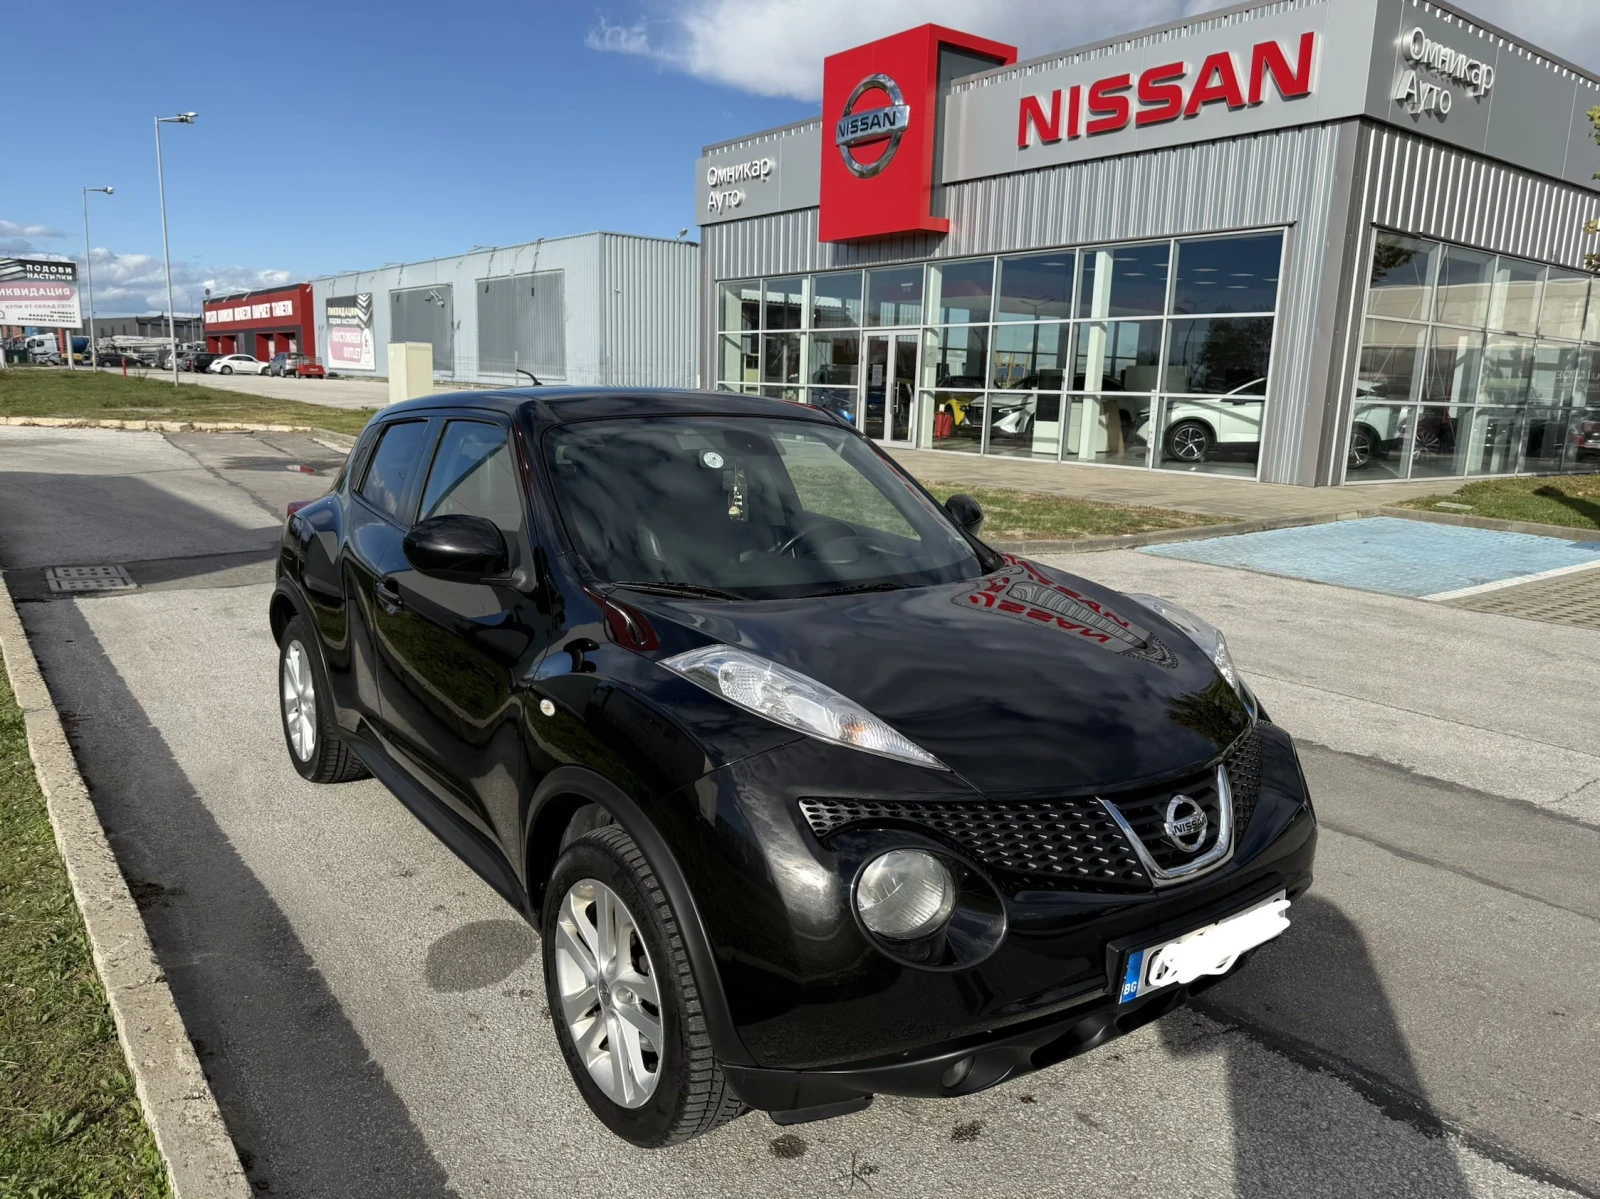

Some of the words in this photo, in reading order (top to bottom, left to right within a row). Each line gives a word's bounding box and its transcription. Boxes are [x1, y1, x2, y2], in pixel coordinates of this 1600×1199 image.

[1404, 26, 1494, 96] Омникар
[1017, 31, 1317, 148] NISSAN
[1398, 69, 1452, 114] Ауто
[837, 111, 896, 139] NISSAN
[706, 157, 772, 186] Омникар
[707, 189, 742, 213] Ауто
[26, 264, 72, 274] ПОДОВИ
[1173, 813, 1207, 834] NISSAN
[1123, 980, 1138, 996] BG
